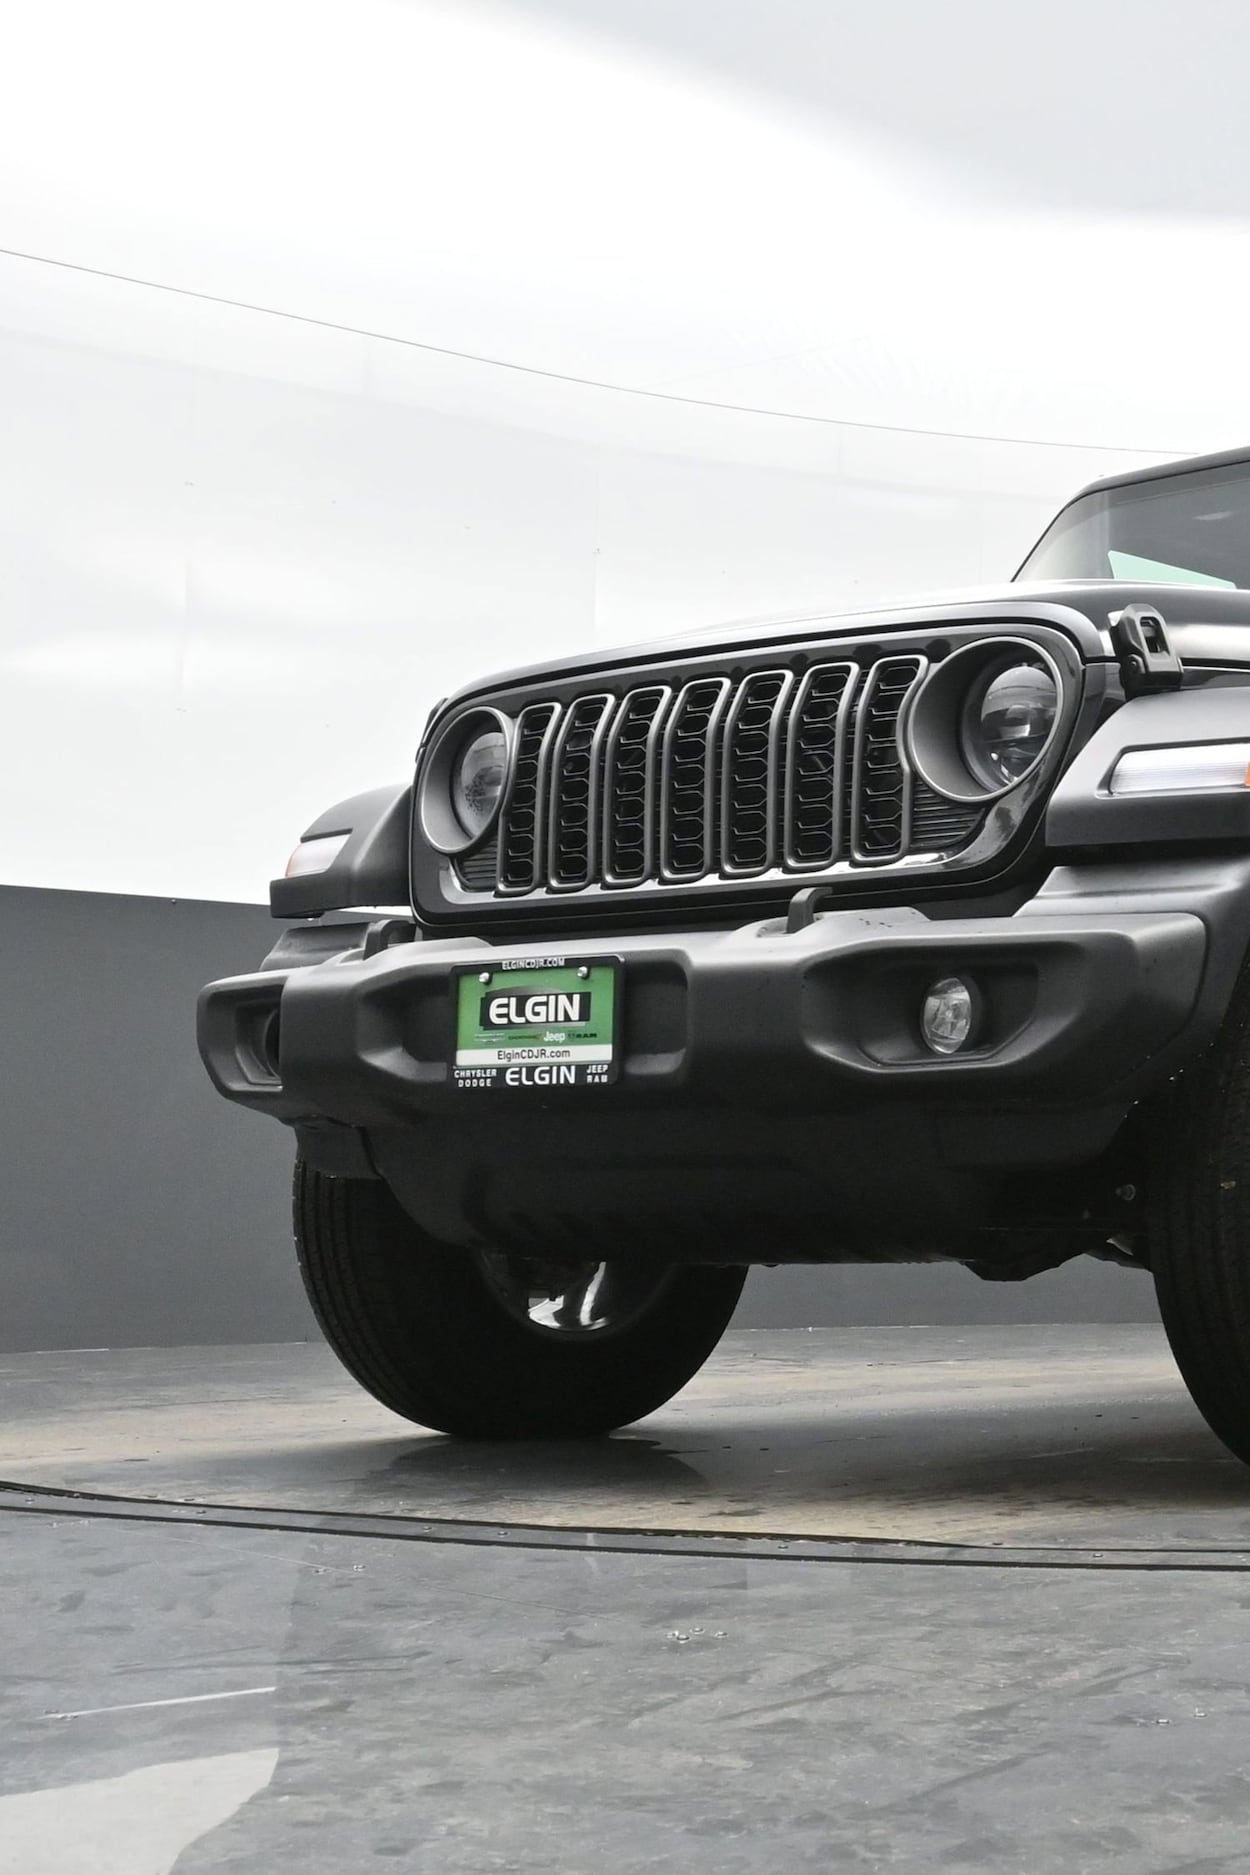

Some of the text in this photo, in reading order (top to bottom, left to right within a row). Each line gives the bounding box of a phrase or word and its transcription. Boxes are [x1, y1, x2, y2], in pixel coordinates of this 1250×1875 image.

[502, 958, 565, 970] ELGINCDJR.COM
[489, 993, 581, 1025] ELGIN
[543, 1031, 566, 1043] Jeep
[497, 1049, 571, 1062] ElginCDJR.com
[454, 1069, 497, 1079] CHRYSLER
[586, 1064, 609, 1074] JEEP
[505, 1065, 576, 1086] ELGIN
[586, 1074, 609, 1084] RAM
[458, 1079, 492, 1088] DODGE
